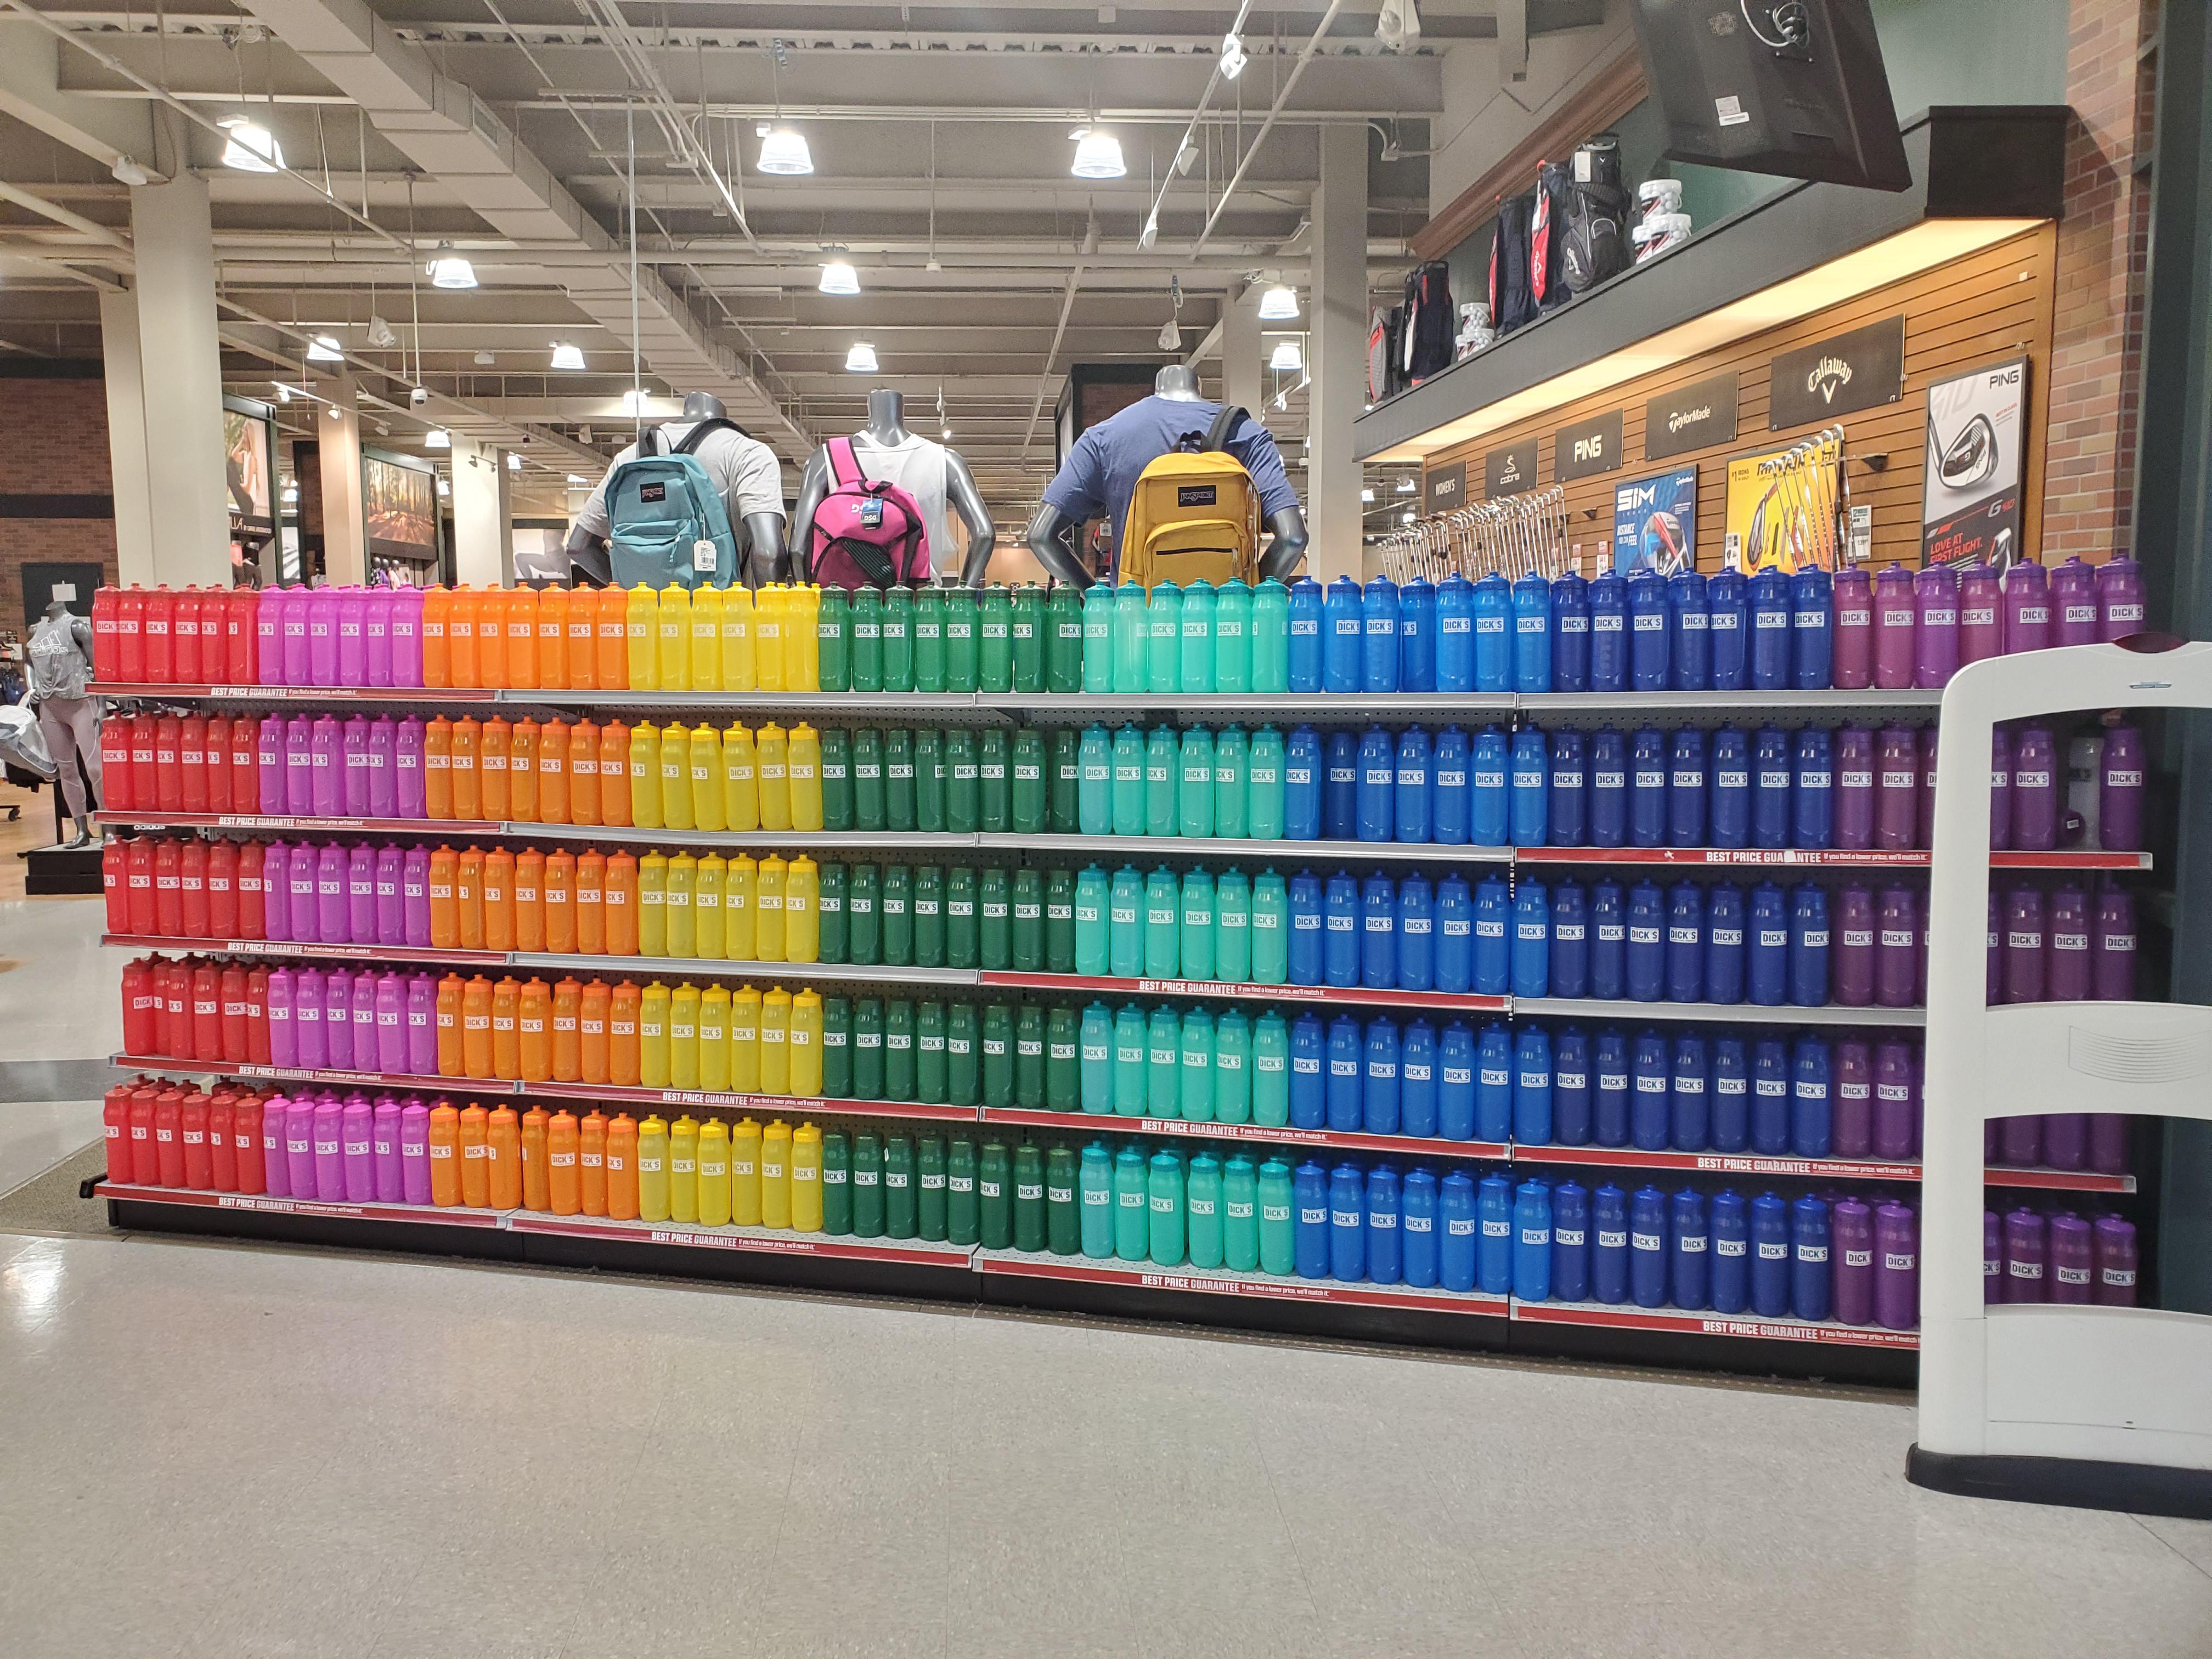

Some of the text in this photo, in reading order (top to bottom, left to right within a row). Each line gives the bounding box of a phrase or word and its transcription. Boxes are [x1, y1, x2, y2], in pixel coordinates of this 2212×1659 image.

[1808, 355, 1853, 392] Callaway
[1989, 369, 2019, 389] PING
[1668, 405, 1711, 433] TaylorMade
[1574, 435, 1602, 462] PING
[1500, 472, 1520, 484] cobra
[1435, 478, 1455, 496] WOMEN'S
[1180, 491, 1214, 502] JANSPORT
[1617, 484, 1656, 511] SIM
[1930, 532, 1963, 555] LOVE AT
[211, 687, 228, 696] BEST
[249, 689, 287, 697] GUARANTEE
[1707, 852, 1731, 862] BEST
[1733, 852, 1762, 862] PRICE
[1764, 853, 1821, 862] GUANTEE
[228, 943, 244, 951] BEST
[245, 943, 264, 952] PRICE
[266, 944, 302, 953] GUARANTEE
[1139, 981, 1235, 994] BEST PRICE GUARANTEE
[239, 1066, 255, 1074] BEST
[256, 1067, 275, 1076] PRICE
[276, 1068, 313, 1078] GUARANTEE
[663, 1092, 681, 1101] BEST
[682, 1093, 703, 1103] PRICE
[706, 1094, 747, 1105] GUARANTEE
[1142, 1120, 1162, 1130] BEST
[1164, 1122, 1187, 1132] PRICE
[1190, 1124, 1238, 1136] GUARANTEE
[1698, 1158, 1722, 1167] BEST
[1724, 1159, 1751, 1170] PRICE
[1754, 1160, 1810, 1172] GUARANTEE
[219, 1197, 235, 1206] BEST
[236, 1198, 255, 1207] PRICE
[257, 1199, 294, 1211] GUARANTEE
[652, 1232, 670, 1241] BEST
[672, 1233, 692, 1243] PRICE
[694, 1235, 736, 1246] GUARANTEE
[1142, 1275, 1163, 1285] BEST
[1165, 1277, 1188, 1287] PRICE
[1191, 1279, 1239, 1292] GUARANTEE
[1703, 1321, 1728, 1332] BEST
[1730, 1322, 1758, 1335] PRICE
[1760, 1325, 1818, 1339] GUARANTEE
